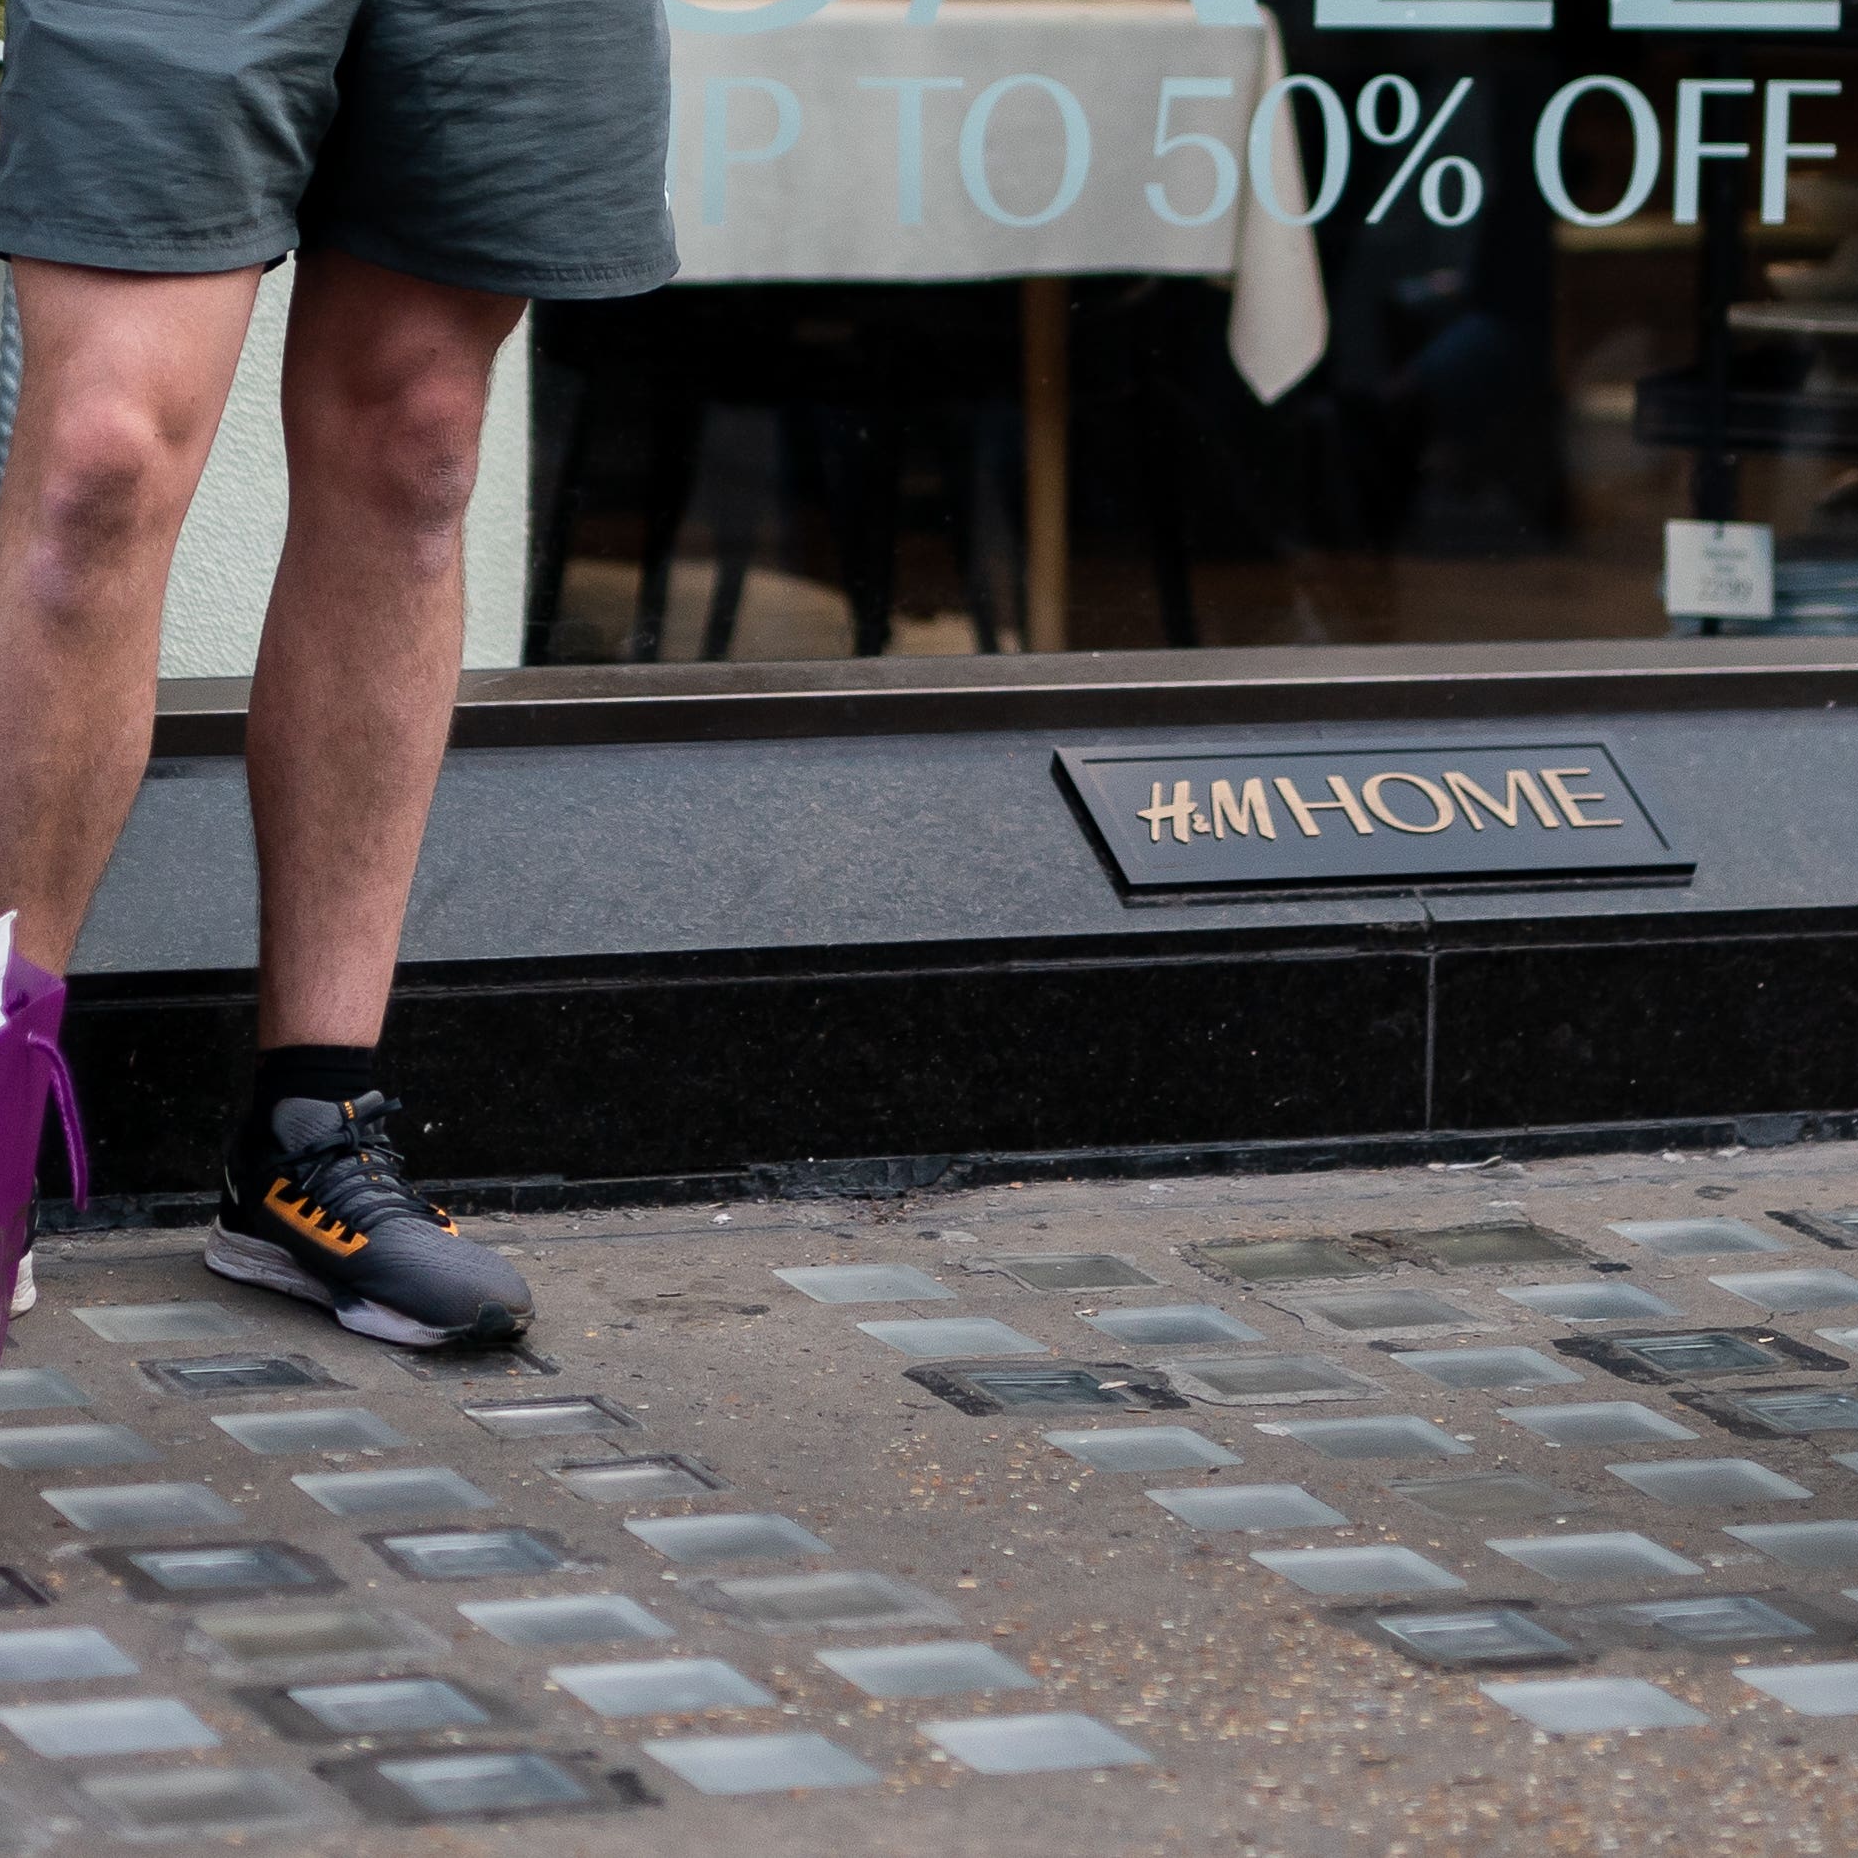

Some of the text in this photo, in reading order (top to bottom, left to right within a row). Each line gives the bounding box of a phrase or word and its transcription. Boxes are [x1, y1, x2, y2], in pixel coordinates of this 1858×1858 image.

[665, 74, 1842, 227] P TO 50% OFF
[1137, 767, 1624, 843] H&M HOME
